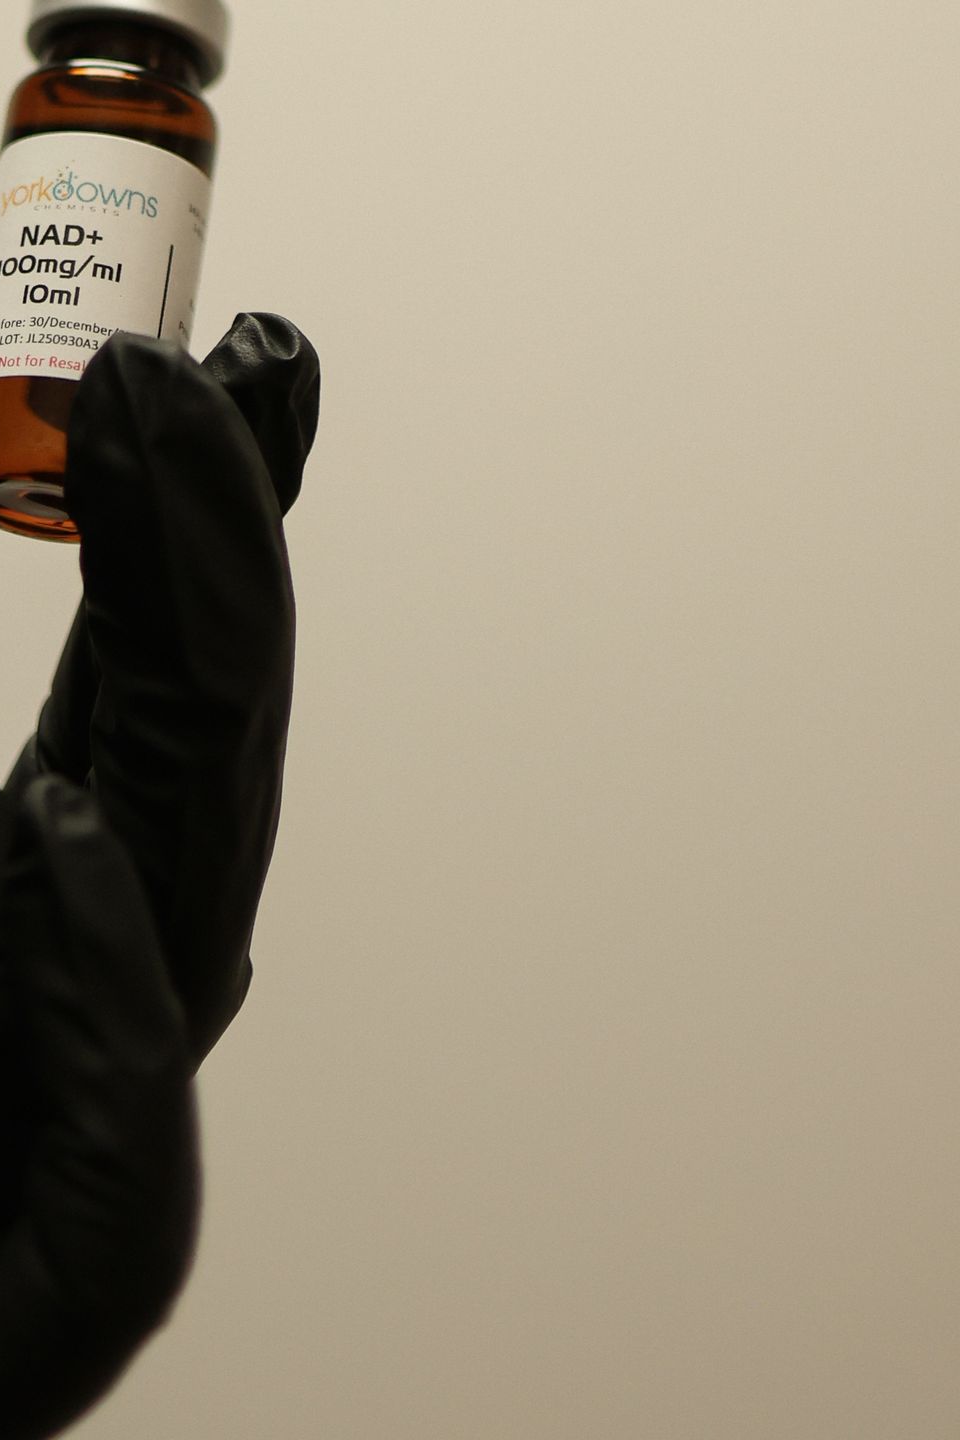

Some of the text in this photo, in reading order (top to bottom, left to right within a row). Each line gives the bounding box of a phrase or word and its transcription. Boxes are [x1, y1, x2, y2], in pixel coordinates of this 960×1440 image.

[1, 171, 159, 218] yorkdowns
[20, 224, 103, 247] NAD+
[22, 284, 80, 306] 10ml
[0, 334, 99, 351] LOT: JL250930A3
[25, 354, 45, 367] for
[48, 355, 87, 372] Resal
